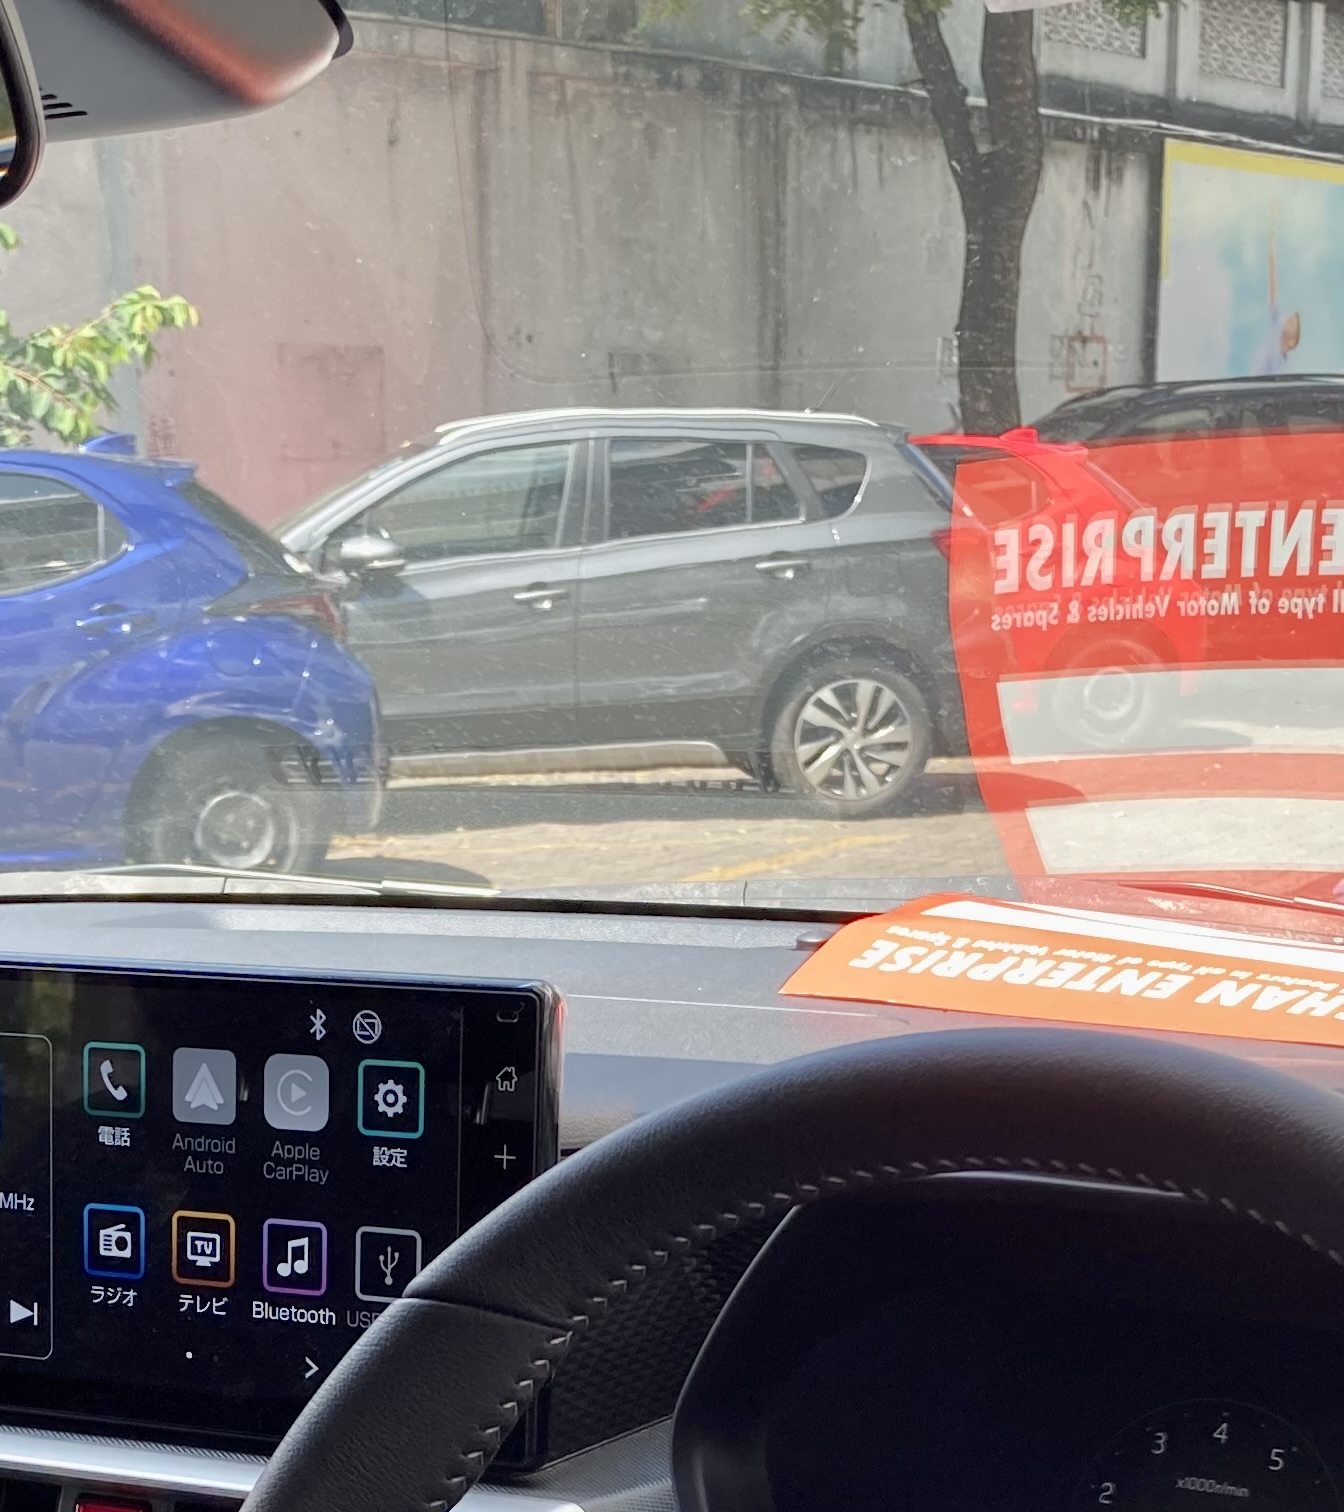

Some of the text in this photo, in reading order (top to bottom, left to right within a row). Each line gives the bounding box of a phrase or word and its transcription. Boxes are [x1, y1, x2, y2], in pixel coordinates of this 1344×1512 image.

[847, 938, 1196, 1000] ENTERPRISE
[98, 1126, 132, 1149] 電話
[171, 1132, 237, 1156] Android
[183, 1154, 225, 1176] Auto
[270, 1141, 322, 1167] Apple
[372, 1146, 408, 1170] 設定
[262, 1163, 330, 1187] CarPlay
[0, 1191, 35, 1212] MHz
[90, 1286, 138, 1308] ラジオ
[178, 1294, 229, 1317] テレビ
[252, 1301, 337, 1327] Bluetooth
[1151, 1432, 1168, 1455] 3
[1212, 1422, 1229, 1445] 4
[1268, 1448, 1285, 1471] 5
[1098, 1482, 1116, 1504] 2
